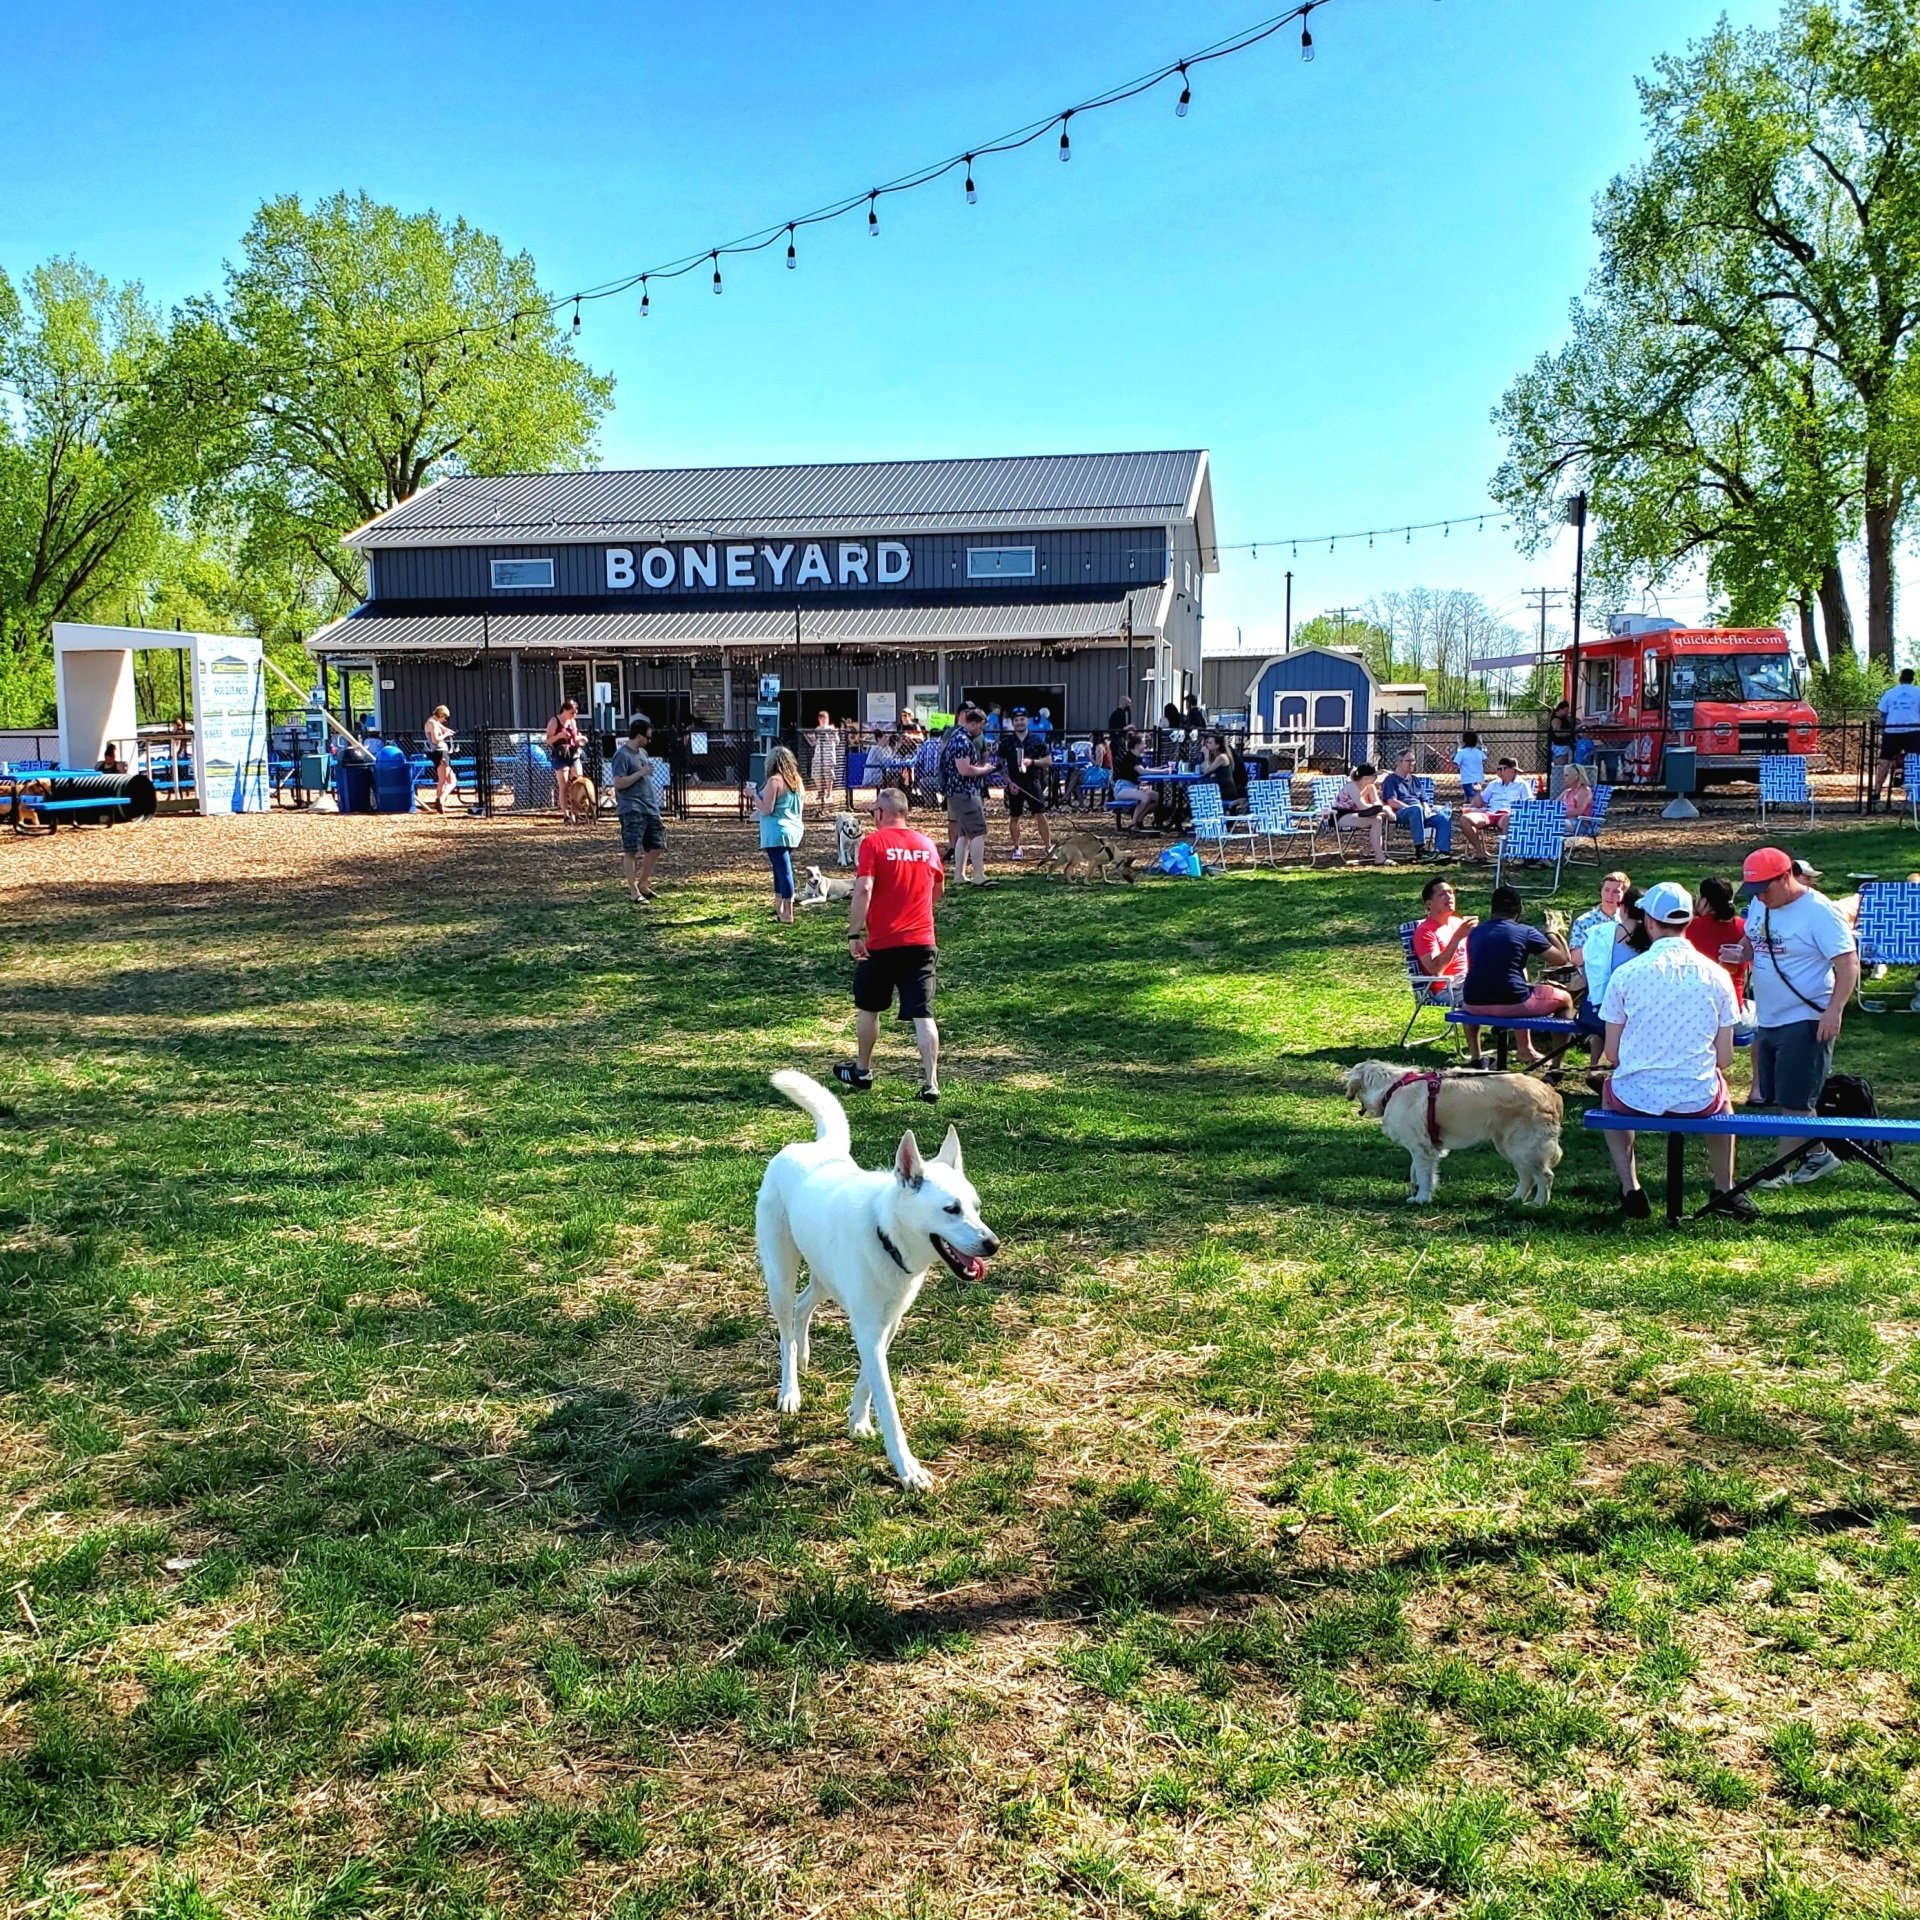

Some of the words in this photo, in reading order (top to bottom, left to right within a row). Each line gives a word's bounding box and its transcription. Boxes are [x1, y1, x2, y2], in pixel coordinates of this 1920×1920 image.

[606, 542, 911, 588] BONEYARD
[1674, 635, 1782, 647] quickchefinc.com
[886, 848, 930, 862] STAFF
